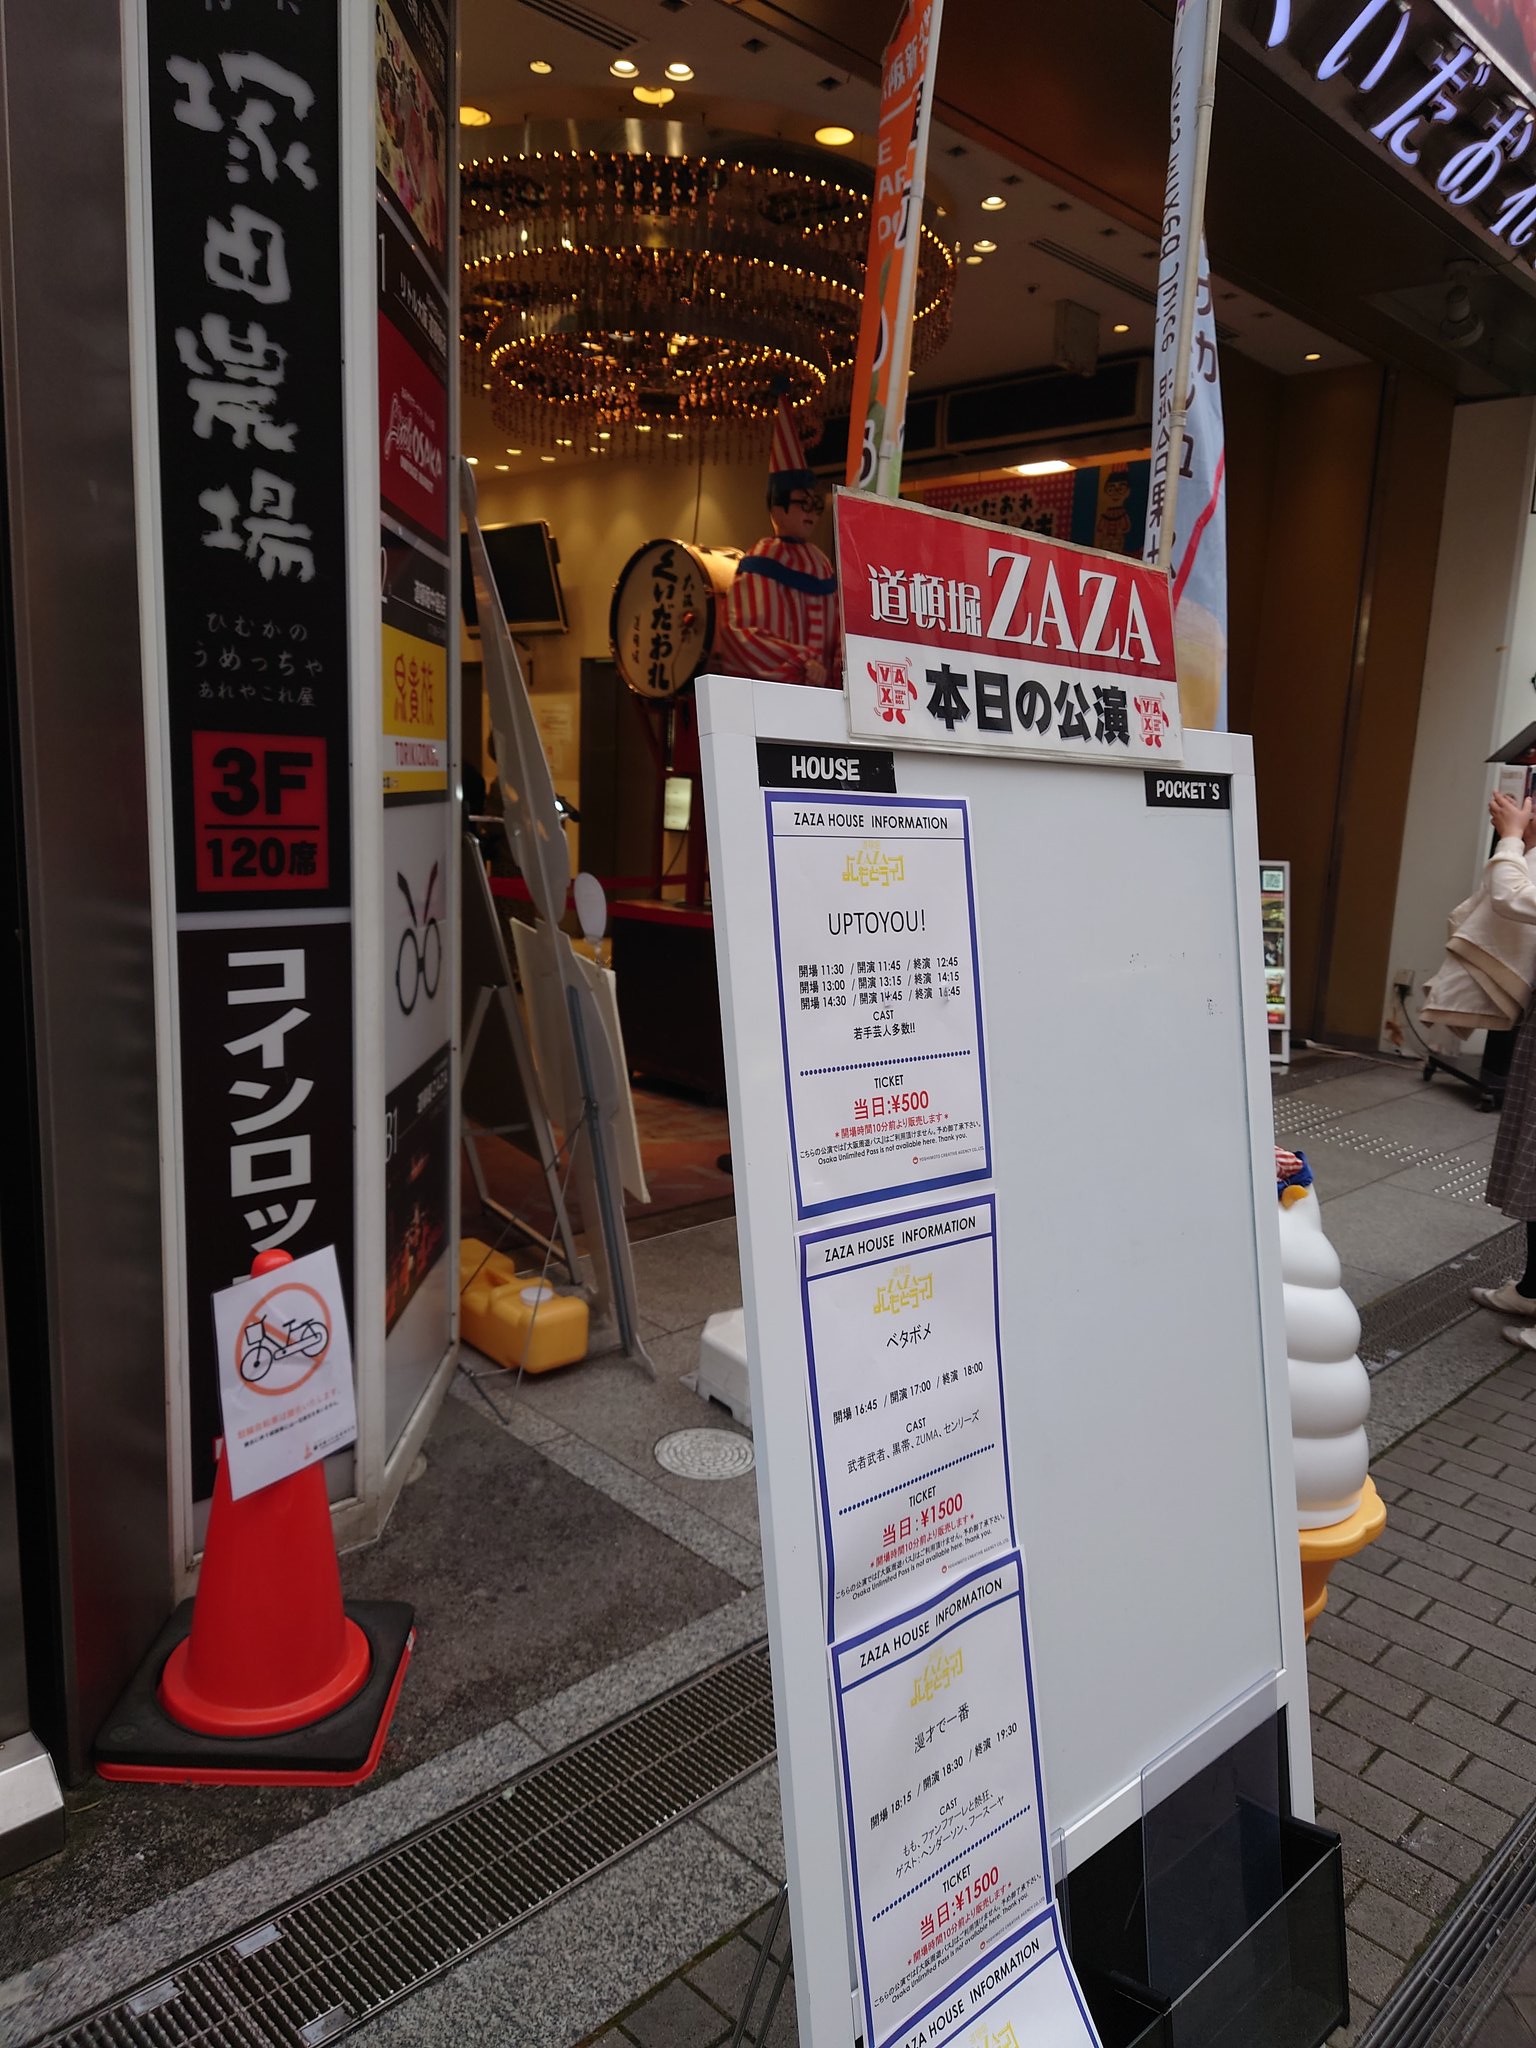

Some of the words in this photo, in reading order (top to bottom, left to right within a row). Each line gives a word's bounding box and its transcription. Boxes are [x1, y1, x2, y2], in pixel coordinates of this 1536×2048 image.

[1266, 0, 1536, 268] いだおれ
[866, 563, 982, 637] 道頓堀
[987, 547, 1161, 665] ZAZA
[206, 612, 307, 641] ひむかの
[198, 681, 317, 707] あれやこれ屋
[925, 663, 1131, 746] 本日の公演
[791, 755, 860, 781] HOUSE
[211, 747, 313, 816] 3F
[794, 812, 825, 826] ZAZA
[829, 814, 864, 828] HOUSE
[871, 815, 948, 829] INFORMATION
[207, 837, 317, 877] 120席
[828, 909, 925, 935] UPTOYOU!
[799, 964, 818, 978] 開場
[821, 964, 844, 976] 11:30
[857, 961, 875, 974] 開演
[878, 961, 901, 972] 11:45
[913, 958, 931, 970] 終演
[936, 957, 958, 968] 12:45
[799, 980, 819, 994] 開場
[822, 980, 845, 992] 13:00
[858, 977, 877, 990] 開演
[879, 976, 902, 987] 13:15
[914, 973, 932, 985] 終演
[937, 971, 959, 983] 14:15
[800, 997, 820, 1010] 開場
[823, 995, 846, 1007] 14:30
[859, 993, 877, 1005] 開演
[915, 987, 933, 1000] 終演
[873, 1010, 894, 1021] CAST
[853, 1022, 915, 1040] 若手芸人多数!!
[874, 1075, 903, 1088] TICKET
[222, 948, 317, 1283] コインロッ
[818, 1155, 837, 1165] Osaka
[838, 1149, 866, 1162] Unlimited
[866, 1147, 879, 1156] Pass
[885, 1145, 895, 1153] not
[896, 1140, 921, 1151] available
[825, 1244, 854, 1262] ZAZA
[858, 1234, 895, 1255] HOUSE
[902, 1216, 976, 1244] INFORMATION
[886, 1323, 931, 1349] ベタボメ
[833, 1407, 852, 1425] 開場
[855, 1399, 878, 1416] 16:45
[889, 1387, 908, 1405] 開演
[910, 1380, 931, 1396] 17:00
[942, 1370, 959, 1386] 終演
[963, 1361, 983, 1376] 18:00
[905, 1417, 927, 1433] CAST
[909, 1485, 937, 1507] TICKET
[860, 1642, 891, 1668] ZAZA
[893, 1621, 930, 1650] HOUSE
[935, 1578, 1002, 1627] INFORMATION
[914, 1702, 970, 1754] 漫才で一番
[870, 1807, 888, 1831] 開場
[891, 1791, 912, 1814] 18:15
[922, 1770, 940, 1792] 開演
[942, 1756, 963, 1777] 18:30
[974, 1737, 991, 1757] 終演
[996, 1723, 1017, 1742] 19:30
[939, 1797, 958, 1816] CAST
[943, 1864, 972, 1894] TICKET
[928, 1999, 965, 2039] HOUSE
[969, 1937, 1041, 2005] INFORMATION
